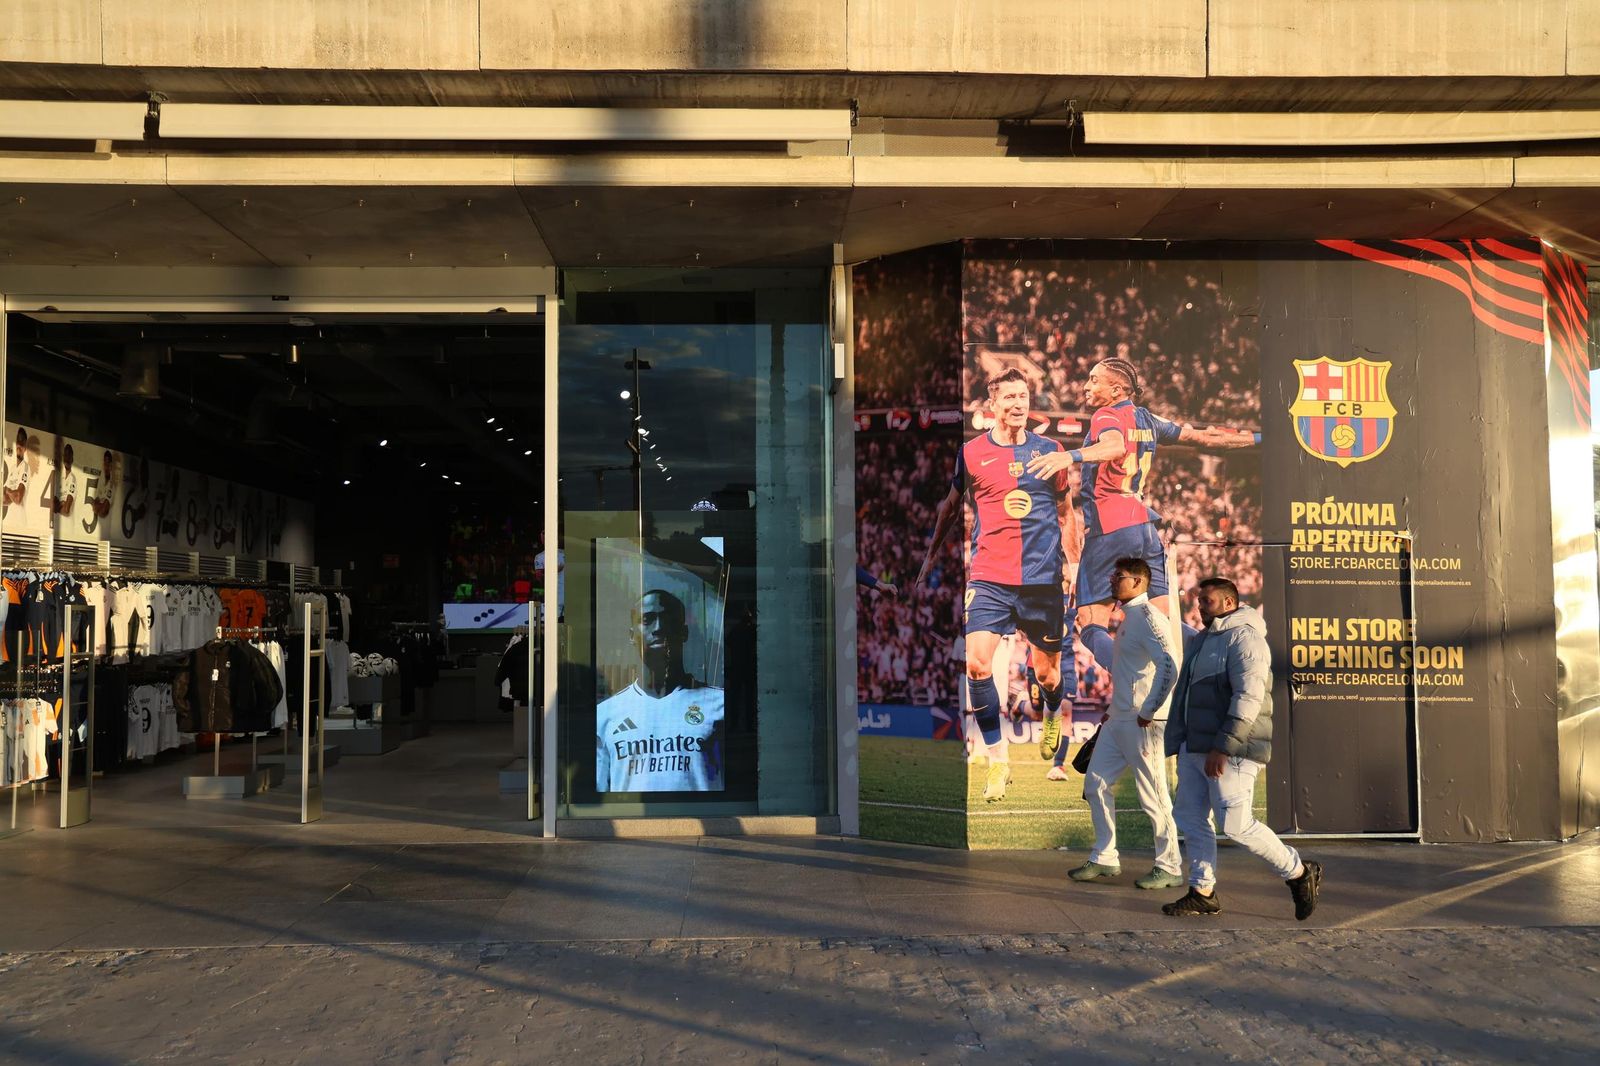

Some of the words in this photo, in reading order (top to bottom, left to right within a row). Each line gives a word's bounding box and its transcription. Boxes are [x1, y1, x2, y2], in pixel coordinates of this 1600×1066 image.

[1323, 402, 1363, 416] FCB
[82, 478, 99, 534] 5
[1291, 496, 1396, 526] PRÓXIMA
[1290, 556, 1461, 570] STORE.FCBARCELONA.COM
[1292, 618, 1340, 641] NEW
[1346, 618, 1417, 642] STORE
[1291, 645, 1394, 669] OPENING
[1400, 646, 1464, 670] SOON
[1292, 673, 1464, 686] STORE.FCBARCELONA.COM
[614, 733, 705, 761] Emirates
[628, 758, 646, 777] FLY
[649, 755, 691, 772] BETTER
